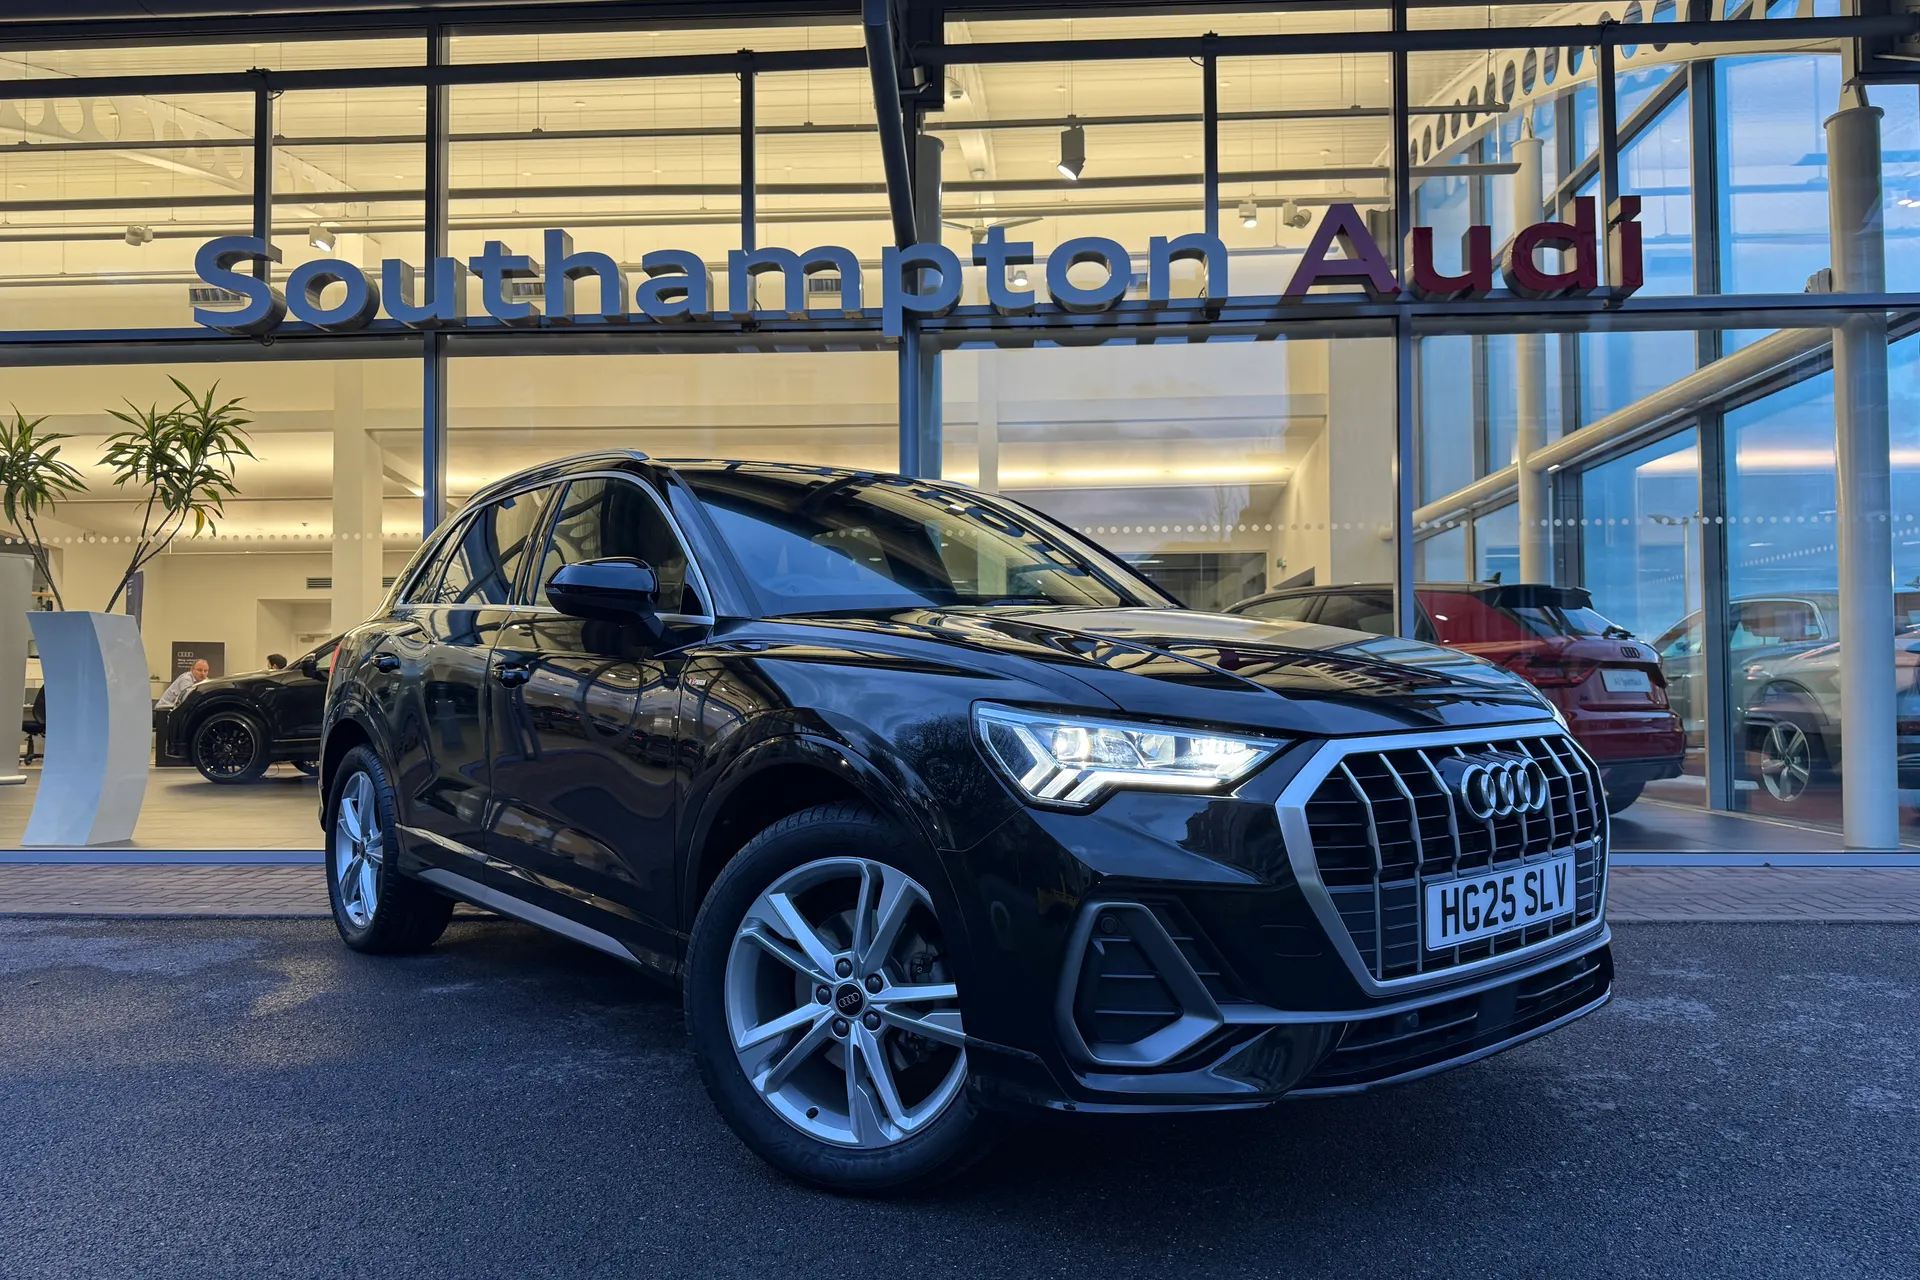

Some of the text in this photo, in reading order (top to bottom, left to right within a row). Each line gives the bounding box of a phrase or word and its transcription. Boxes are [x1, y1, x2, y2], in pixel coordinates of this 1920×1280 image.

[193, 195, 1643, 337] Southampton Audi
[1441, 862, 1567, 938] HG25 SLV
